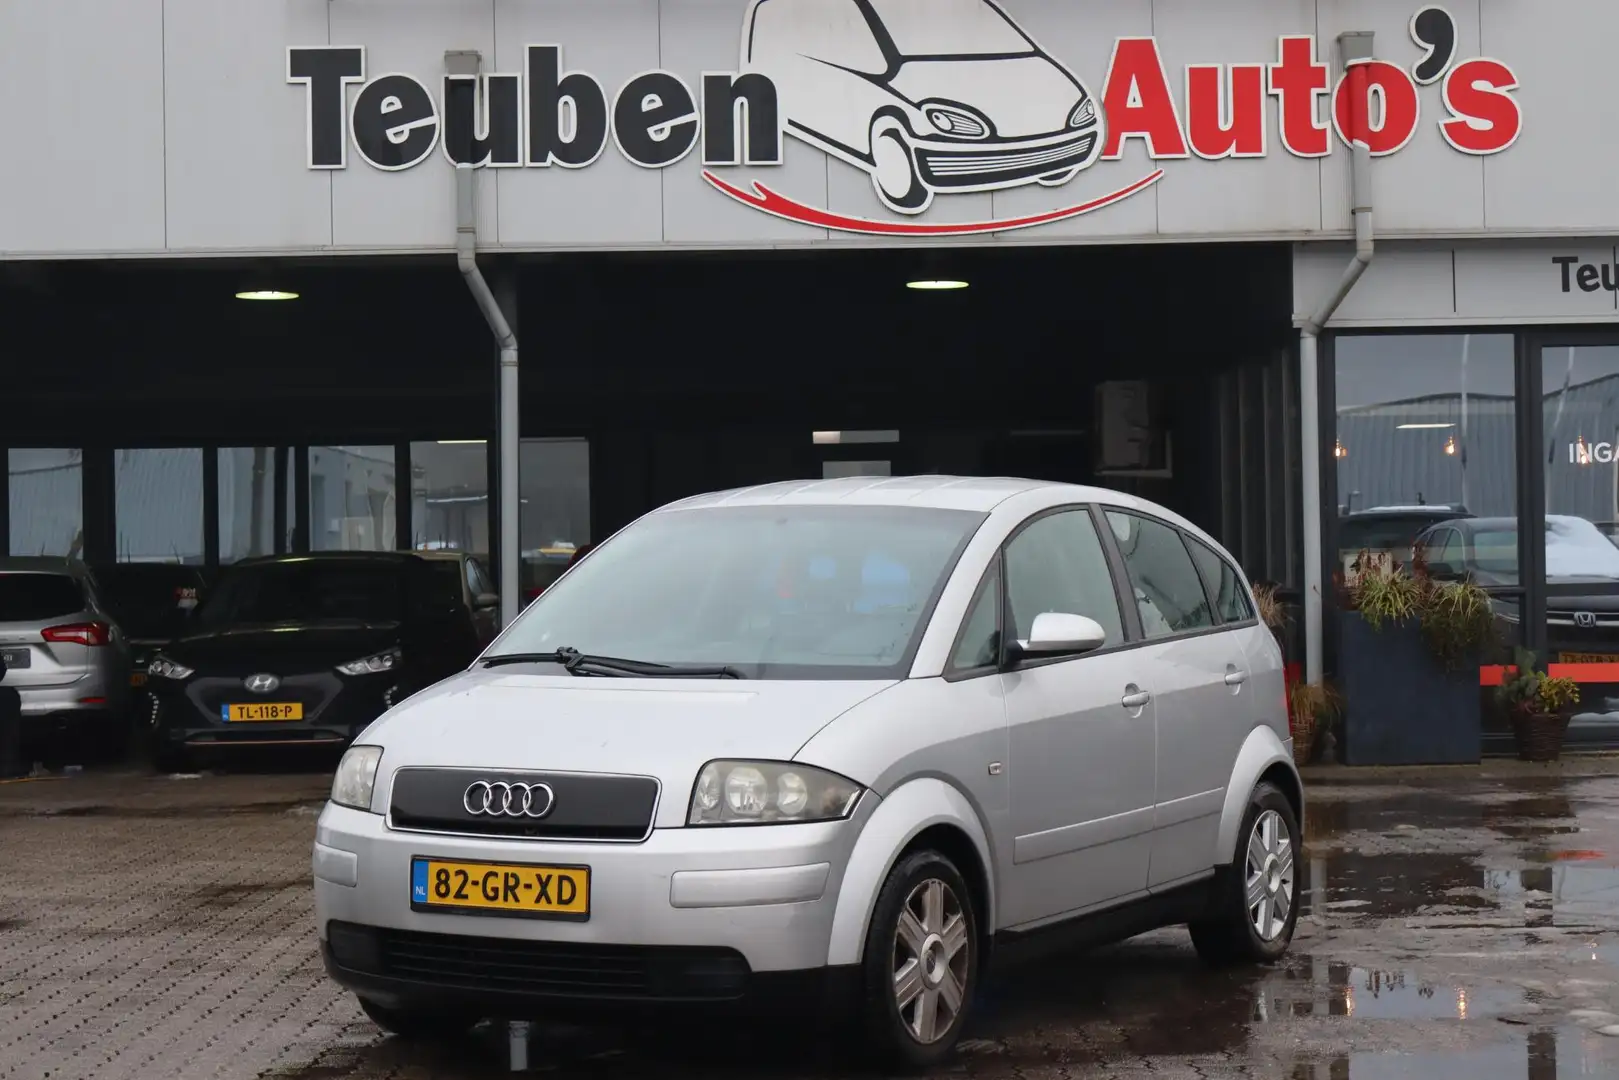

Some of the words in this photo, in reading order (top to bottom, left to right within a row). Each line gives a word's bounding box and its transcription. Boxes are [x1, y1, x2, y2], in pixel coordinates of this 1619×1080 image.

[286, 43, 782, 171] Teuben
[1100, 5, 1523, 159] Auto's
[1551, 256, 1619, 292] Teu
[237, 705, 293, 719] TL-118-P
[415, 886, 426, 896] NL
[434, 867, 577, 905] 82-GR-XD
